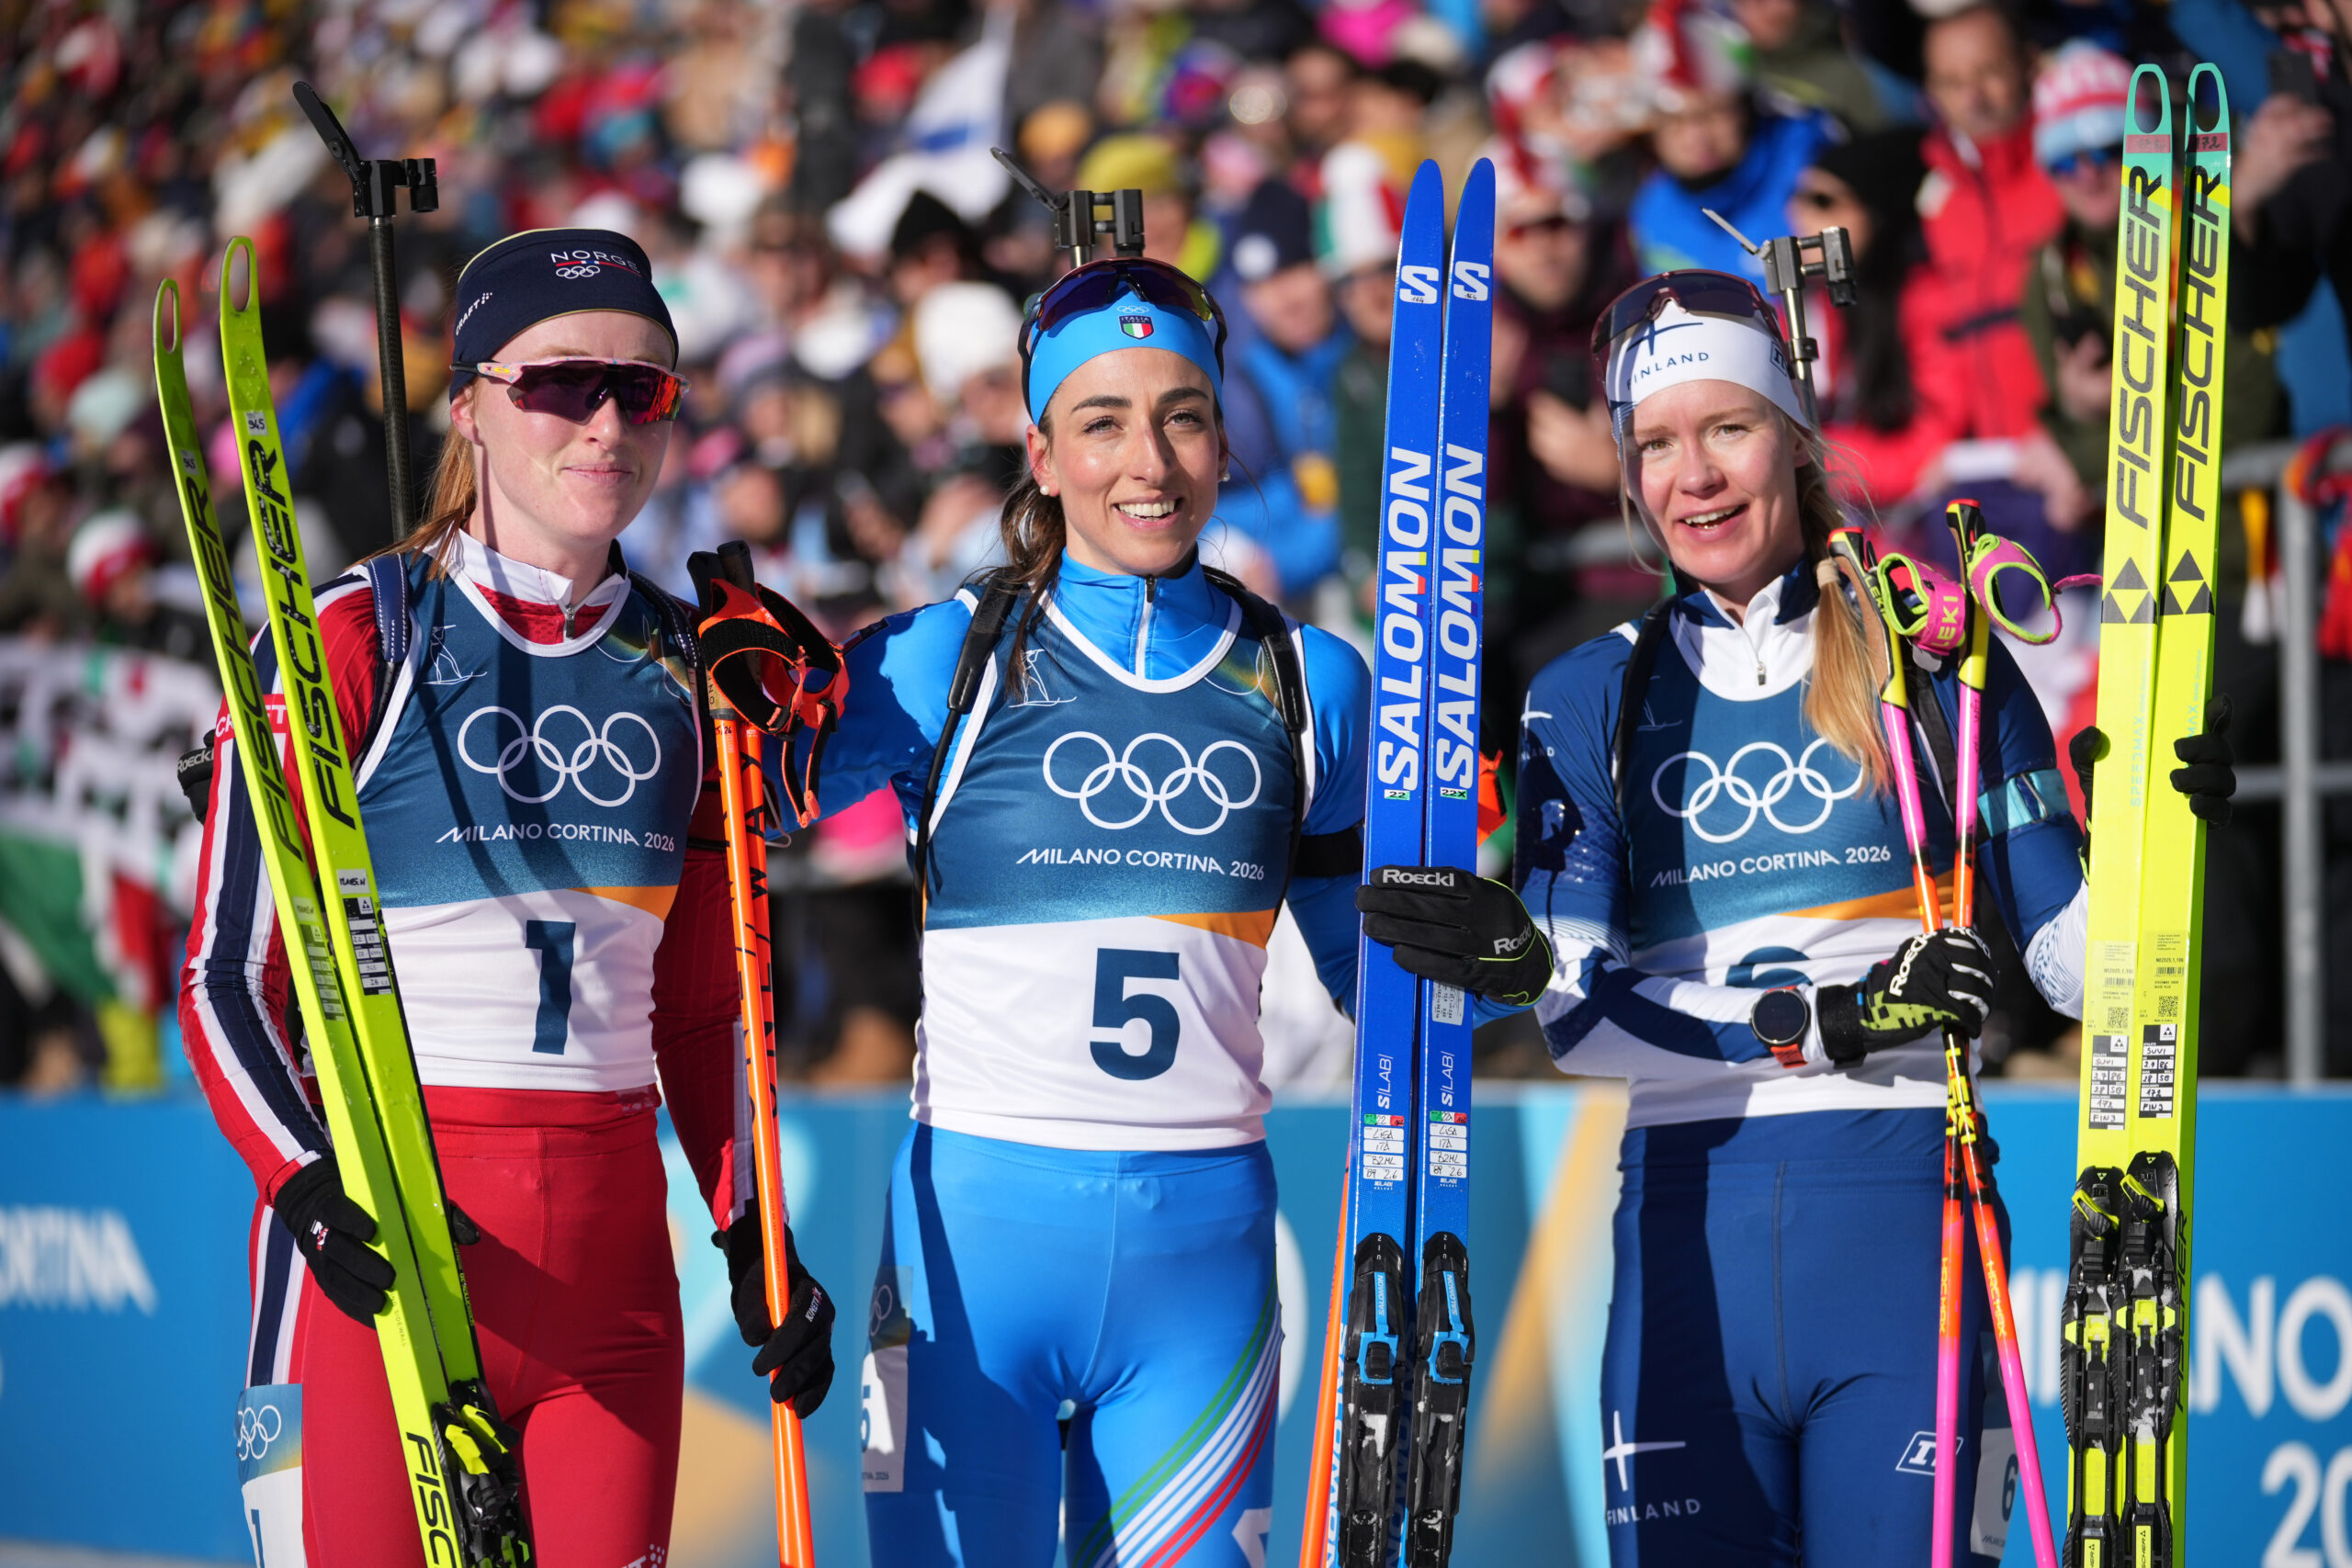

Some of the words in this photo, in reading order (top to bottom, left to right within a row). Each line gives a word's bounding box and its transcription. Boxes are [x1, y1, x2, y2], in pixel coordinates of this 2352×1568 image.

[550, 250, 640, 275] NORGE
[455, 299, 481, 336] CRAFT
[2116, 164, 2163, 531] FISCHER
[2175, 164, 2222, 522] FISCHER
[1626, 351, 1710, 390] FINLAND
[248, 439, 356, 831] FISCHER
[1377, 446, 1431, 792] SALOMON
[1436, 442, 1484, 790] SALOMON
[1931, 595, 1959, 649] LEKI
[186, 477, 304, 863] FISCHER
[2131, 715, 2145, 807] SPEEDMAX
[1388, 790, 1408, 799] 22
[1441, 788, 1466, 798] 22X
[435, 823, 543, 843] MILANO
[547, 823, 640, 847] CORTINA
[644, 831, 675, 852] 2026
[1015, 847, 1121, 864] MILANO
[1125, 848, 1227, 875] CORTINA
[1229, 859, 1265, 882] 2026
[1650, 860, 1737, 888] MILANO
[1740, 849, 1840, 874] CORTINA
[1845, 845, 1892, 865] 2026
[526, 919, 577, 1056] 1
[1090, 947, 1182, 1082] 5
[2146, 1046, 2166, 1055] SUVI
[1376, 1274, 1385, 1317] SALOMON
[1446, 1273, 1458, 1317] SALOMON
[1606, 1497, 1702, 1527] FINLAND
[2001, 1452, 2019, 1523] 6
[250, 1508, 265, 1568] 1
